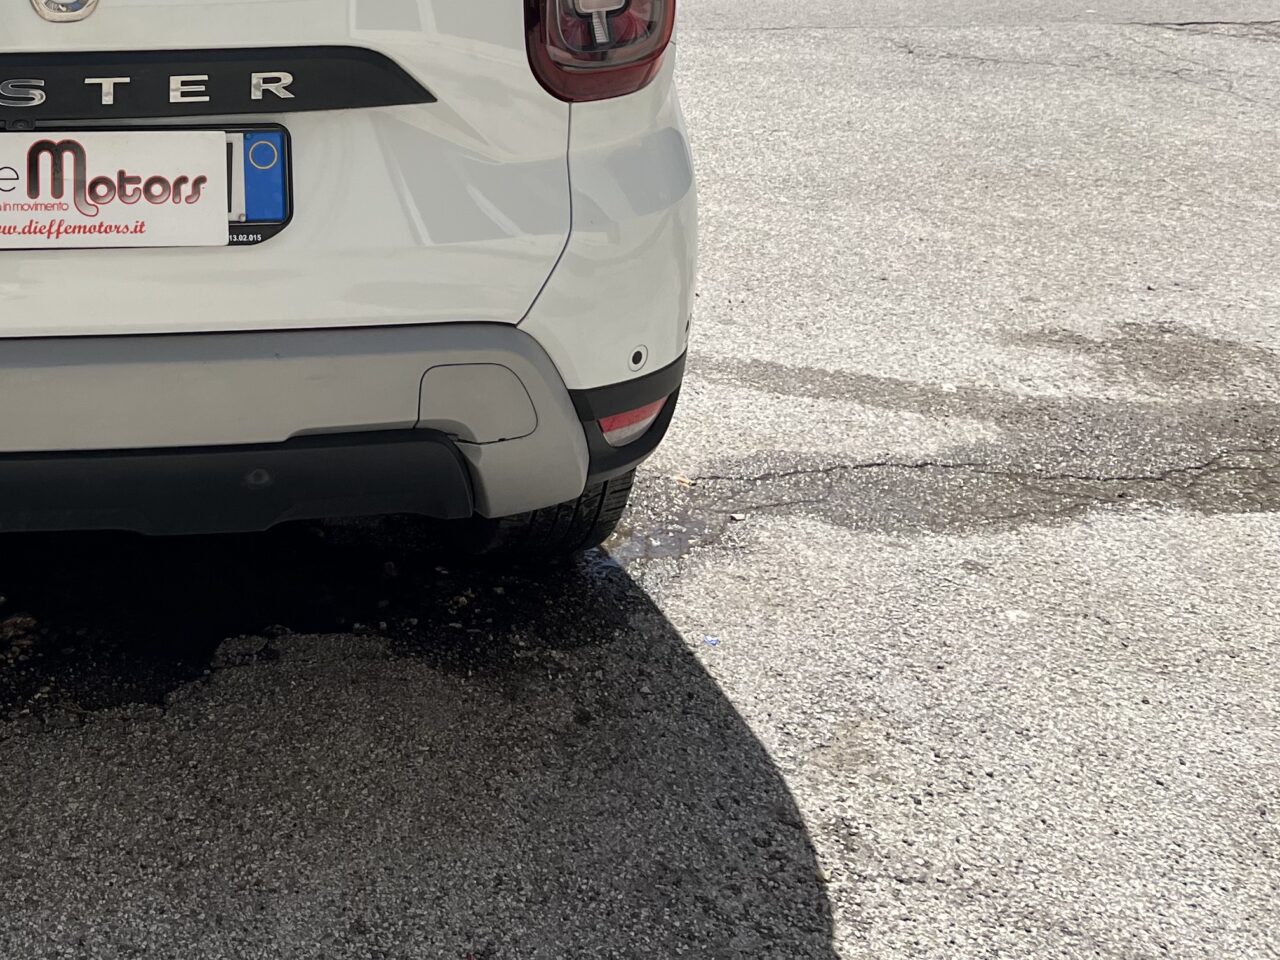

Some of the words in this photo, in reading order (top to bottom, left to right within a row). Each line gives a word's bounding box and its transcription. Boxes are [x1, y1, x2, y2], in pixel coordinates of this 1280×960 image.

[26, 139, 208, 217] Motors
[3, 202, 11, 211] in
[13, 201, 70, 211] movimento
